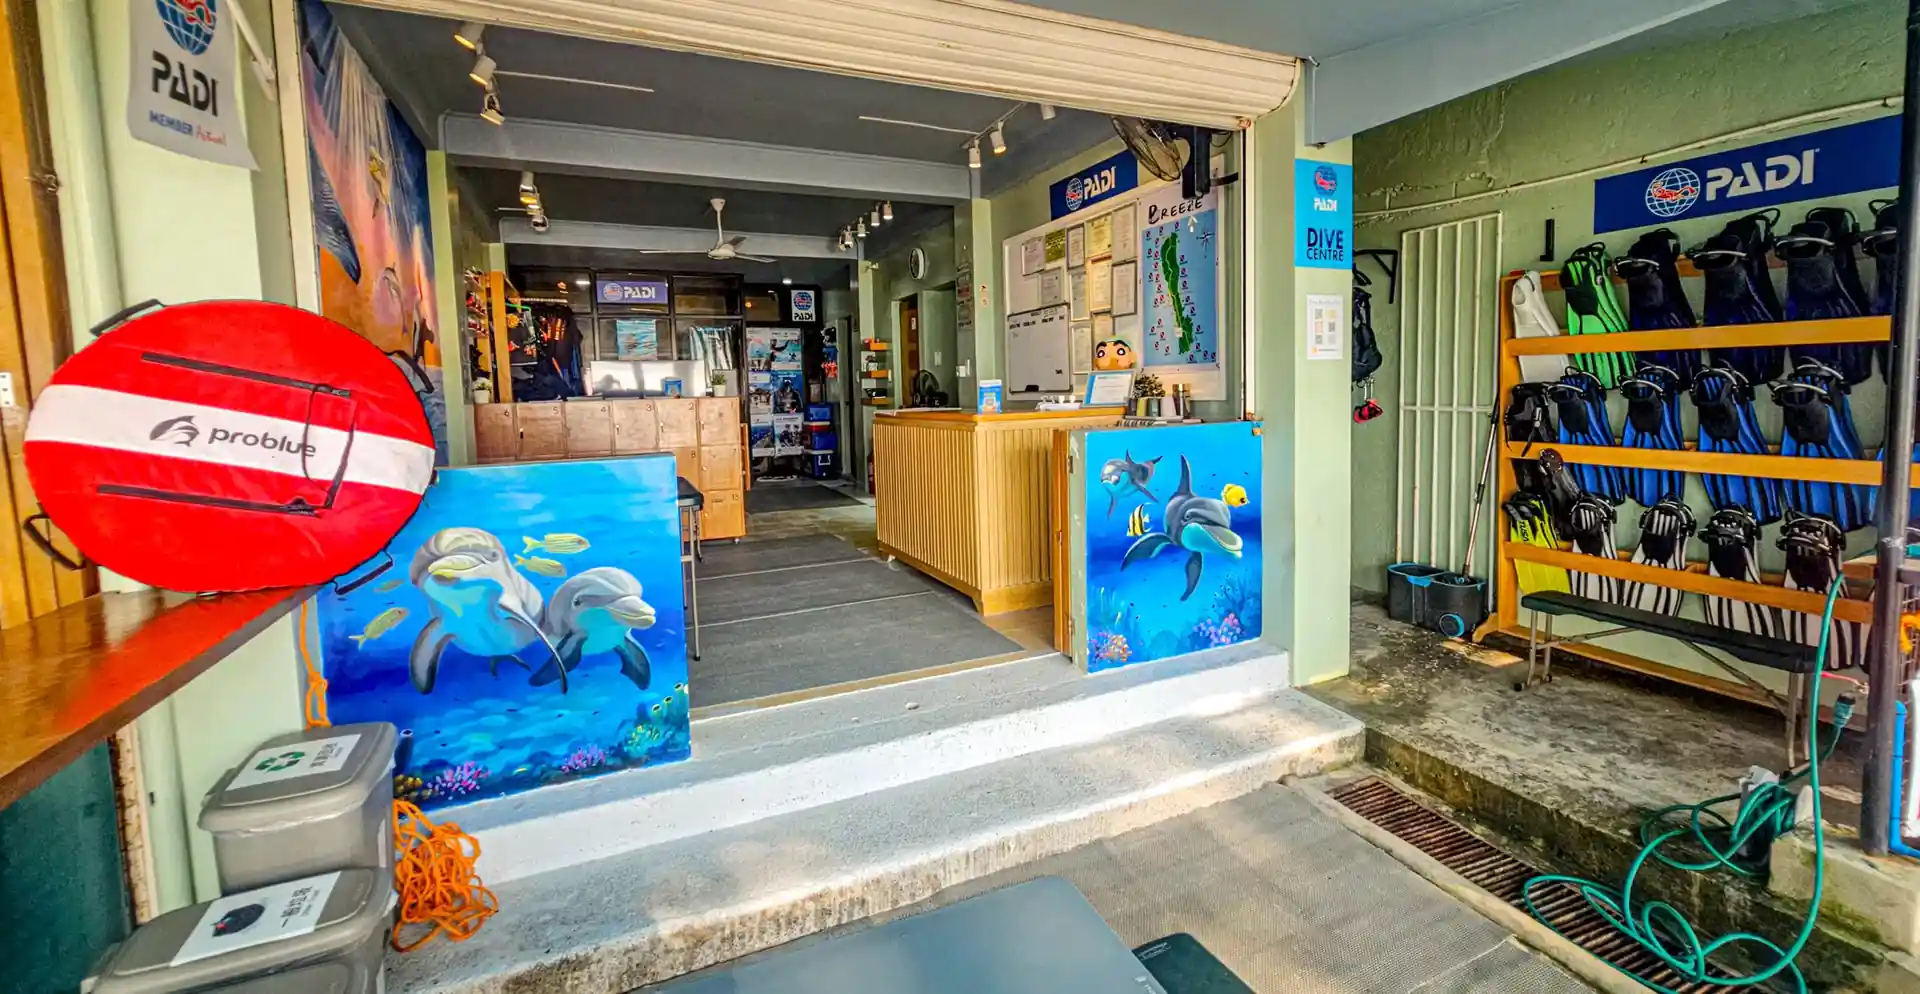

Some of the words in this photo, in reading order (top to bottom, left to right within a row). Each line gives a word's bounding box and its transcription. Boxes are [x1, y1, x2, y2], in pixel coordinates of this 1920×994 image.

[152, 49, 219, 117] PADI
[148, 109, 194, 136] MEMBER
[1083, 165, 1117, 200] PADI
[1706, 148, 1816, 202] PADI
[1313, 197, 1338, 212] PADI
[1307, 227, 1344, 250] DIVE
[1306, 248, 1345, 262] CENTRE
[624, 286, 656, 299] PADI
[794, 312, 813, 321] PADI
[600, 404, 606, 413] 4
[688, 403, 695, 411] 2
[207, 427, 317, 457] problue
